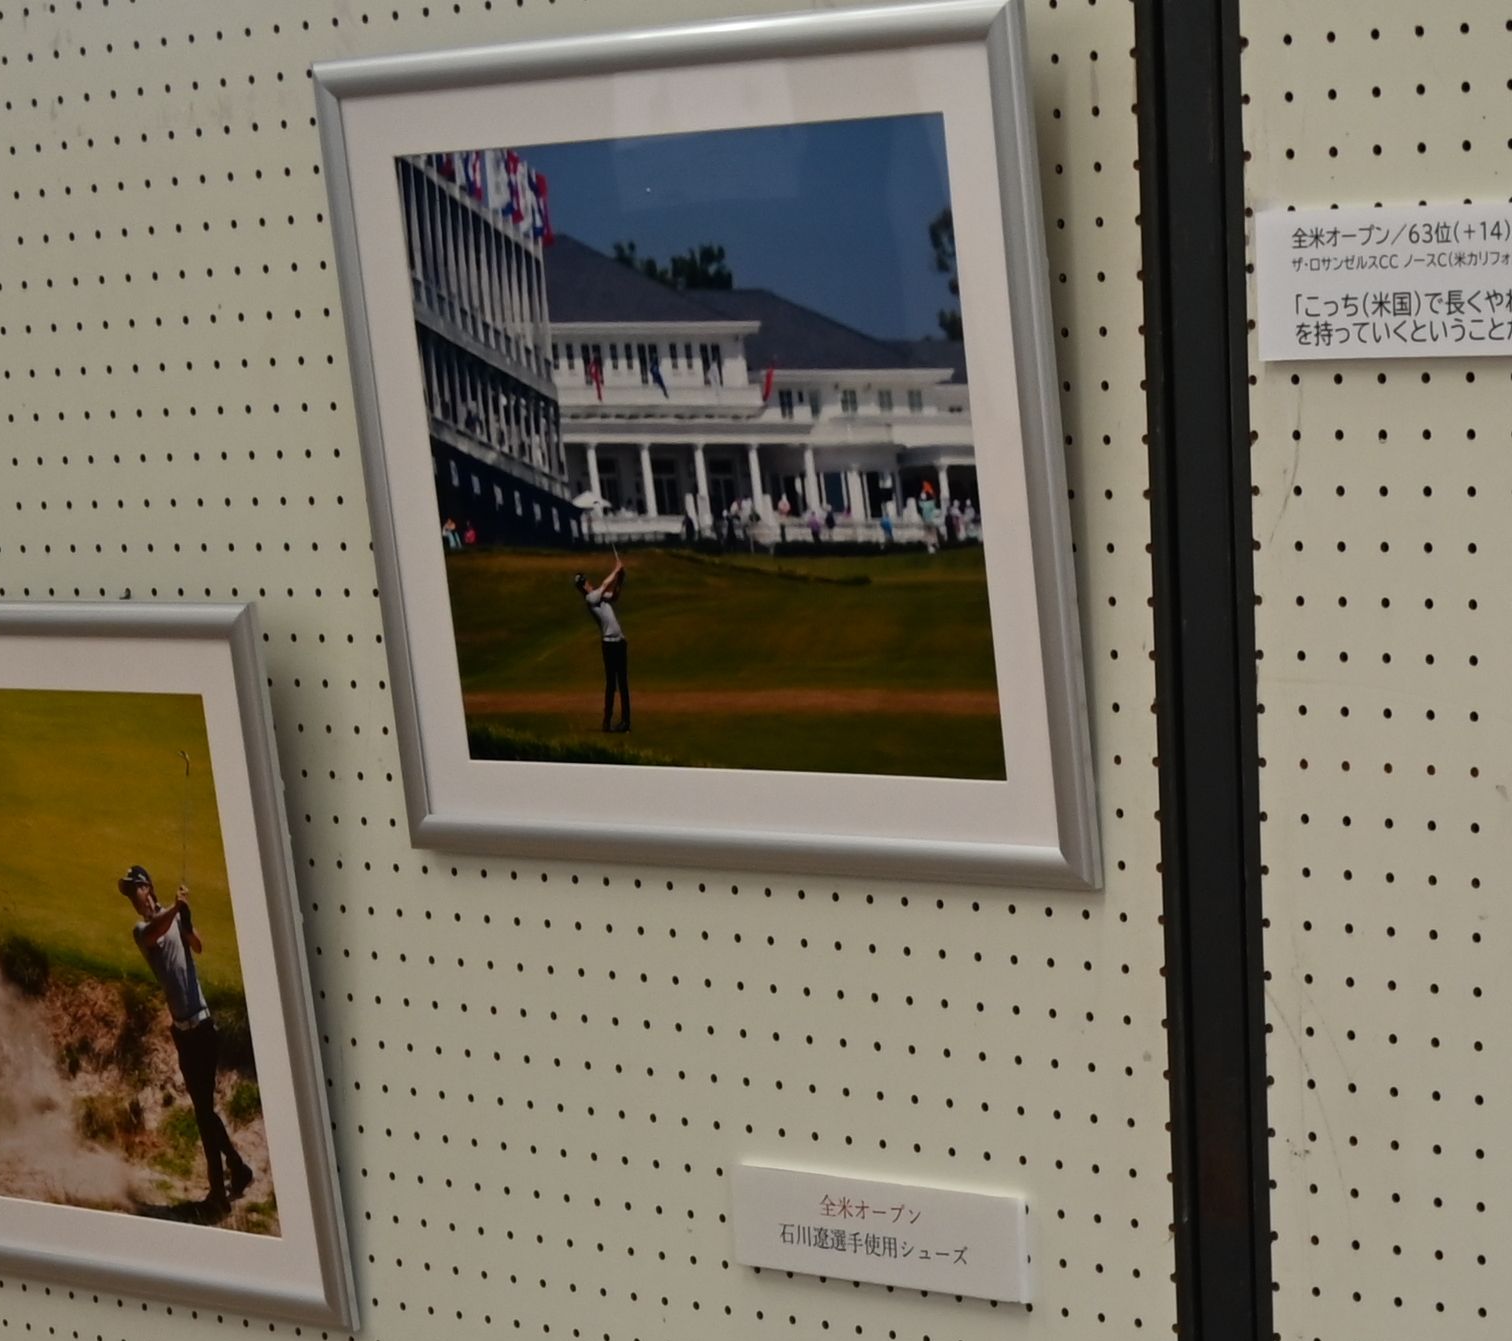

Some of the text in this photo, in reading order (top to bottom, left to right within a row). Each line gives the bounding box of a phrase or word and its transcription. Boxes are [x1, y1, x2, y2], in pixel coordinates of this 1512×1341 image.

[819, 1194, 921, 1225] 全米オープン
[779, 1223, 968, 1265] 石川遼選手使用シューズ
